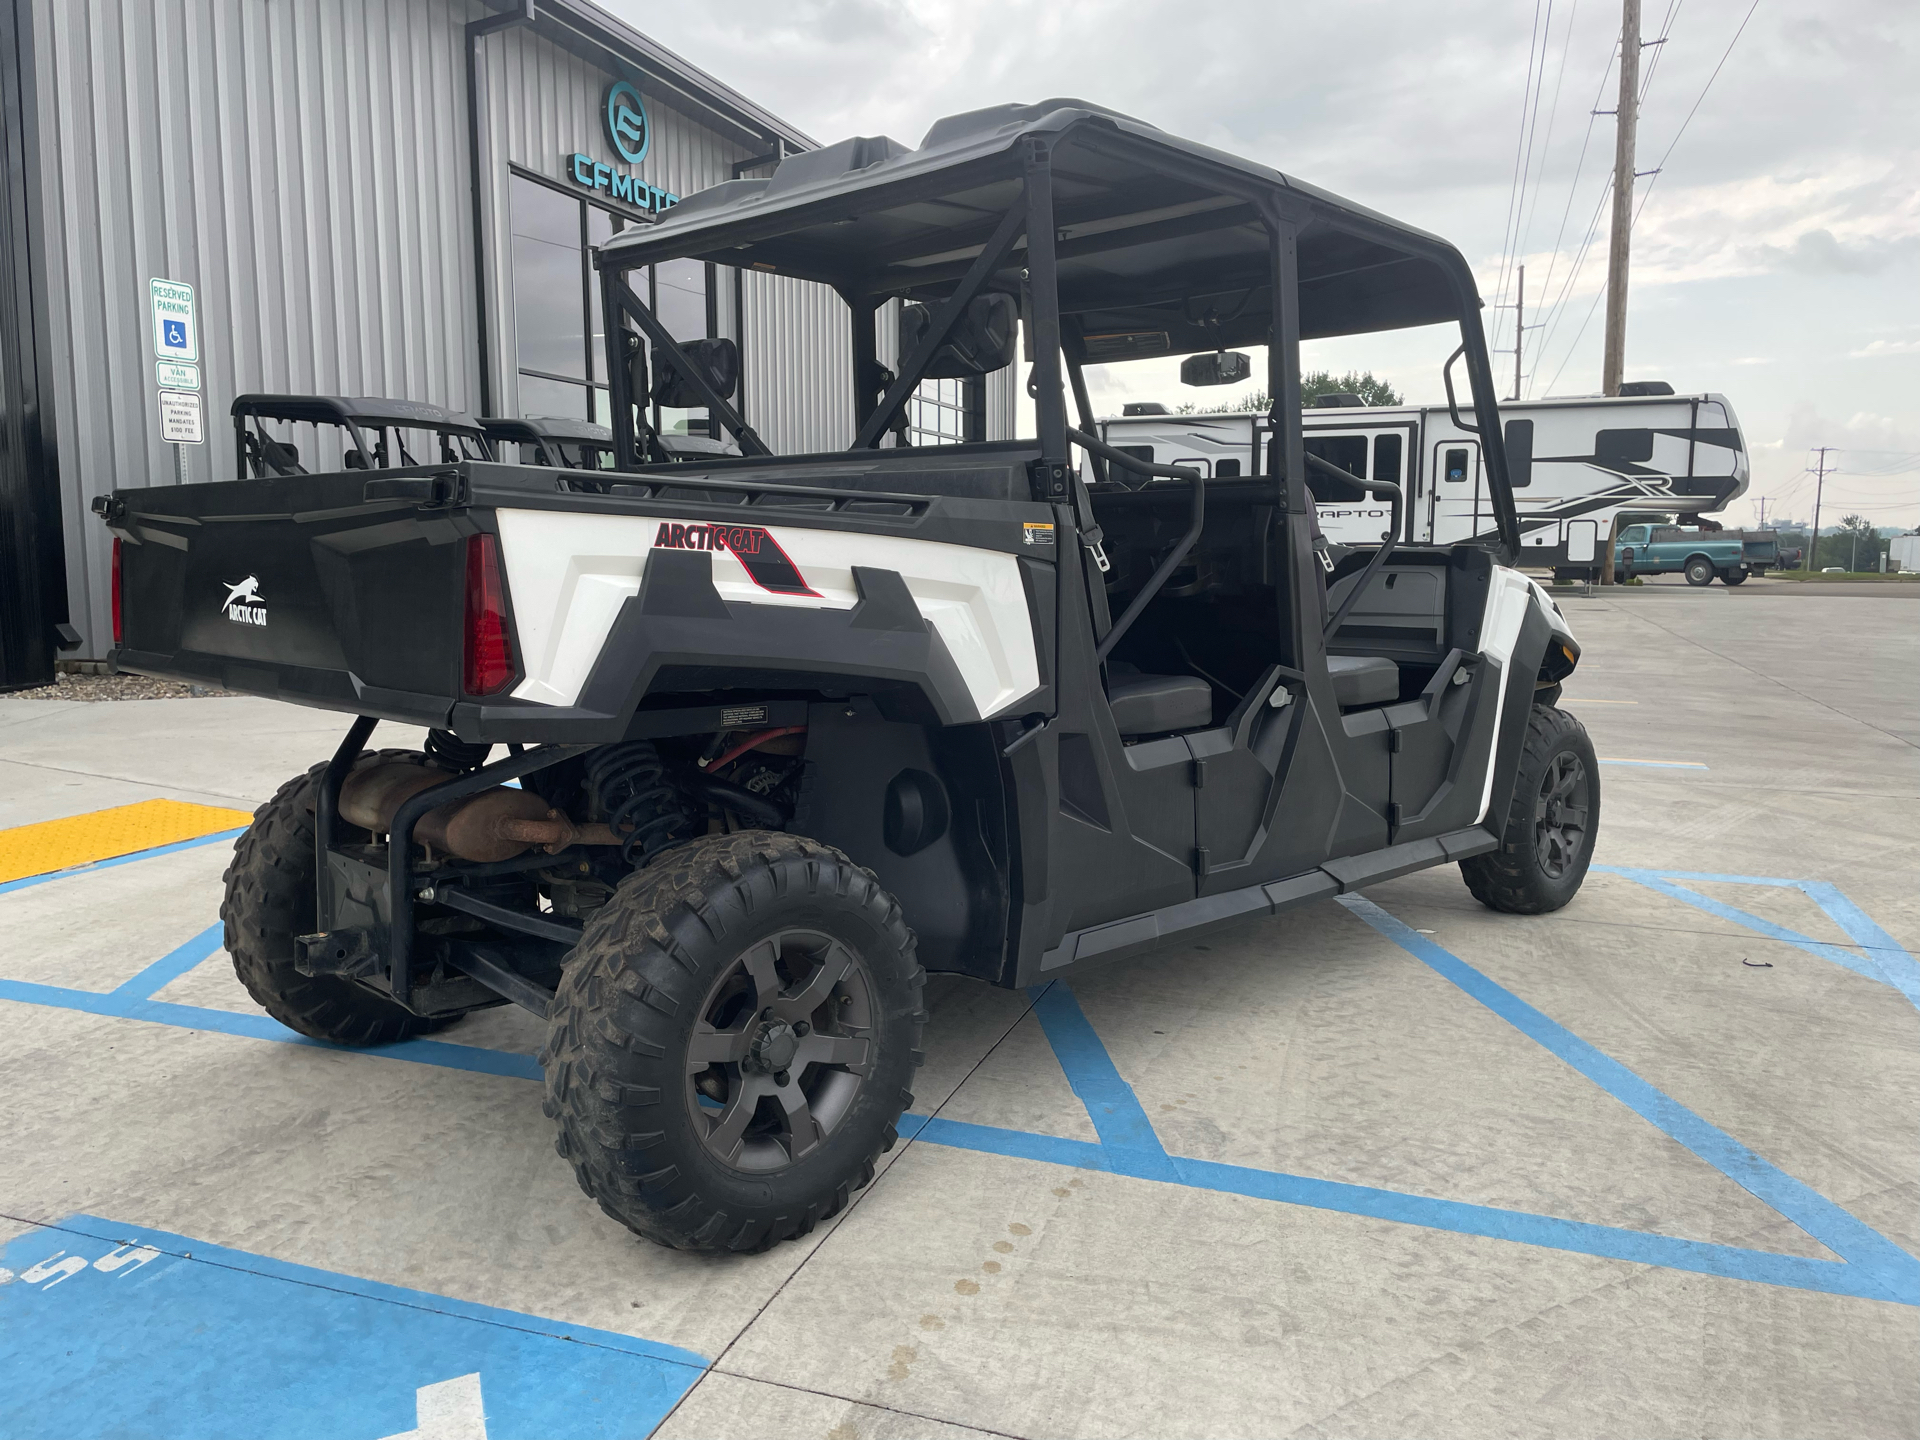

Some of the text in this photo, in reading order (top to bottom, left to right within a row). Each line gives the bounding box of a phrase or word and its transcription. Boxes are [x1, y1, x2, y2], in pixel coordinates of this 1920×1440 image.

[154, 286, 191, 302] RESERVED
[157, 301, 190, 315] PARKING
[170, 368, 186, 377] VAN
[163, 375, 194, 385] ACCESSIBLE
[161, 400, 199, 409] UNAUTHORIZED
[170, 409, 192, 417] PARKING
[168, 418, 195, 426] MANDATES
[654, 522, 764, 553] ARCTIC CAT
[229, 604, 267, 626] ARCTIC CAT
